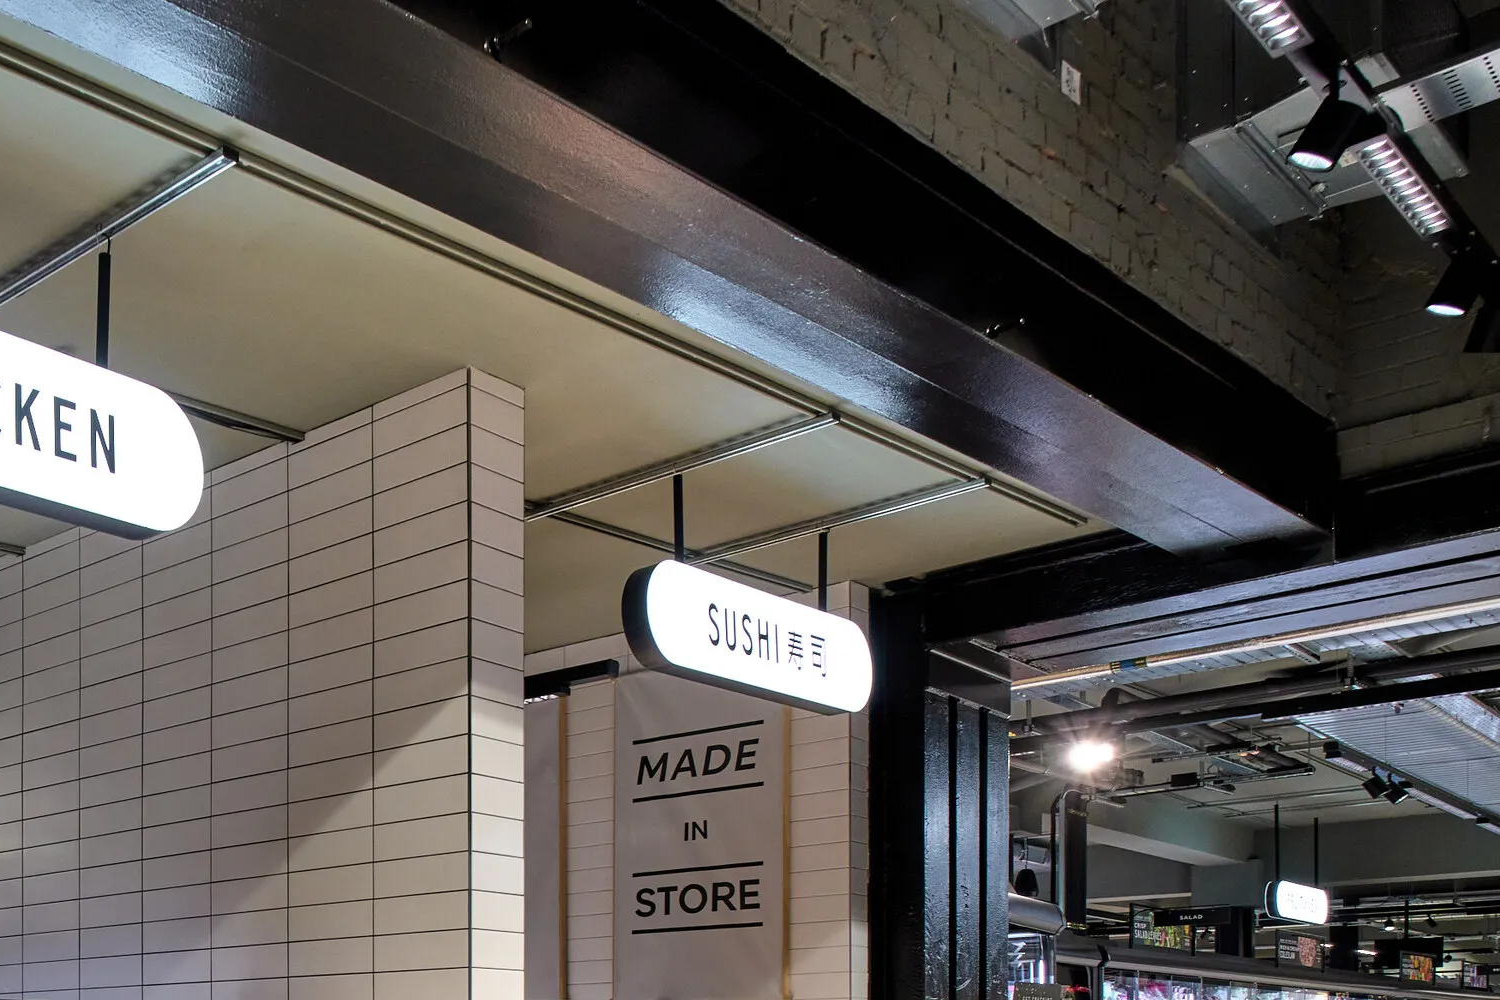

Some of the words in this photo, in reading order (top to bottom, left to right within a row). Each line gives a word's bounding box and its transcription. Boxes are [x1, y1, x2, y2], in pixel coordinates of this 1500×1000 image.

[708, 603, 779, 663] SUSHI
[636, 738, 759, 785] MADE
[683, 820, 708, 841] IN
[635, 879, 760, 917] STORE
